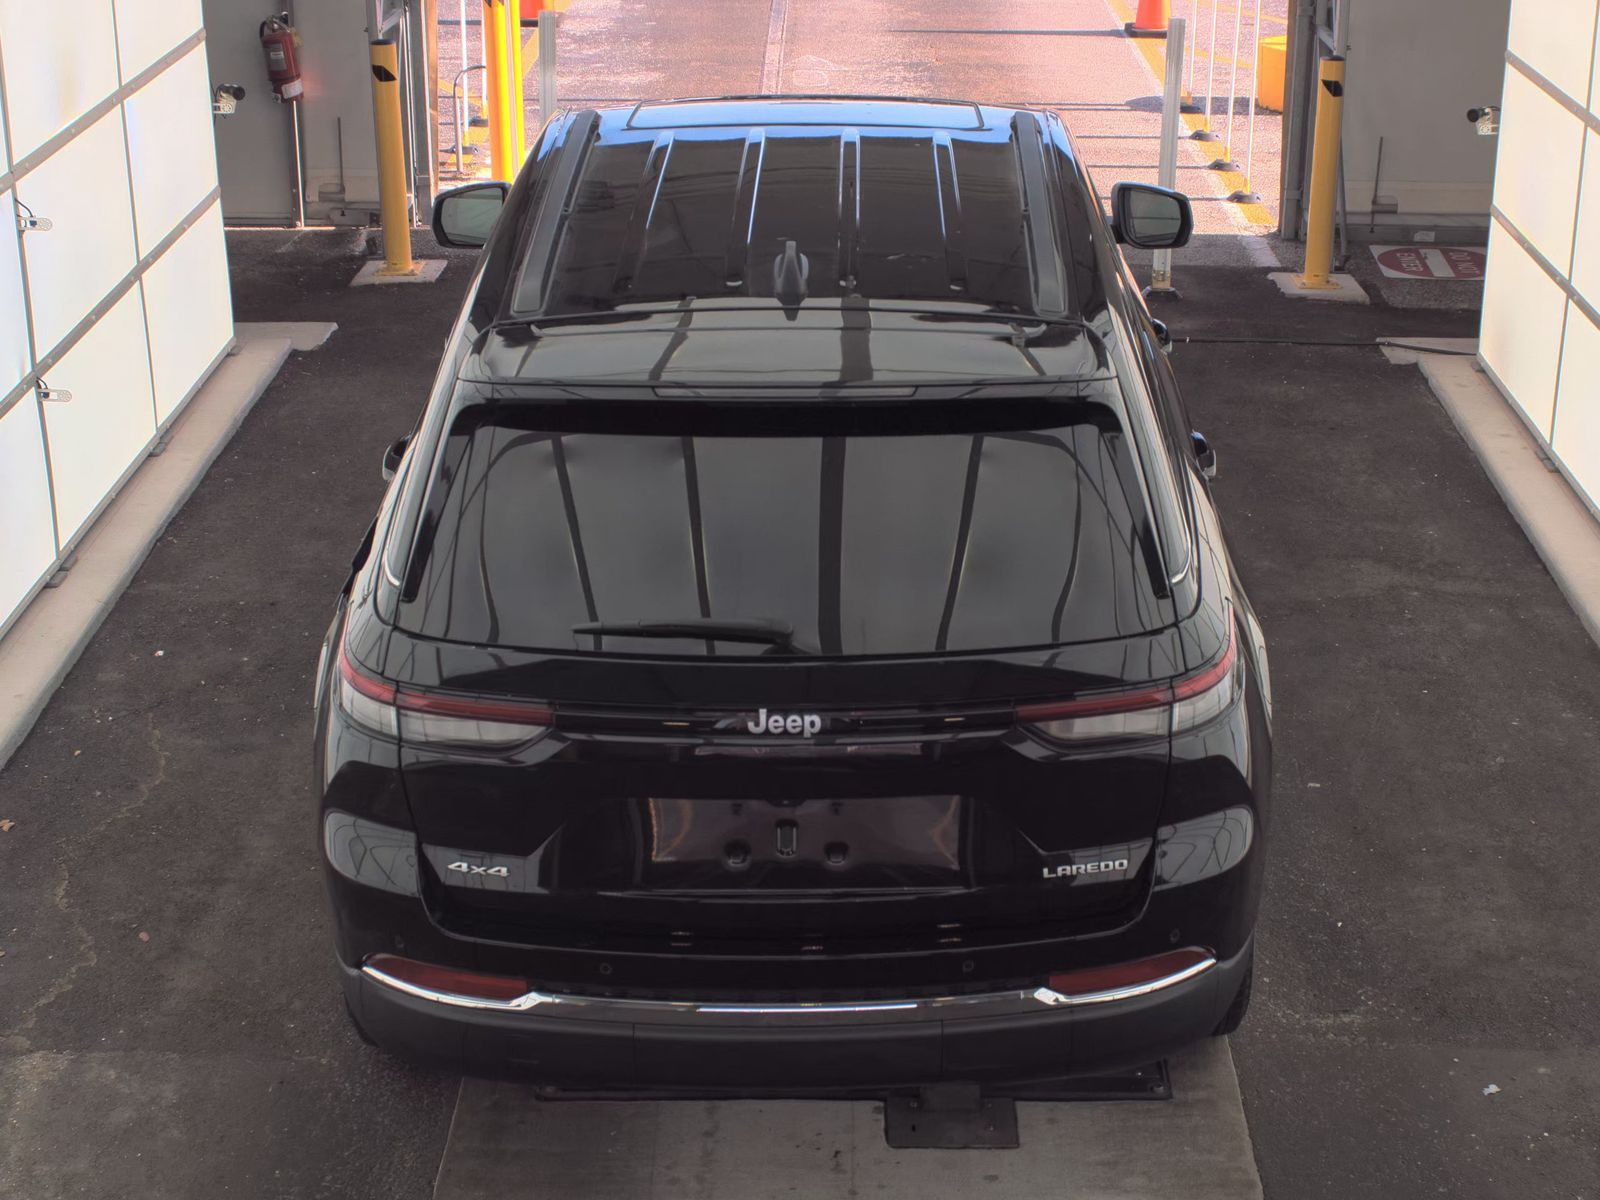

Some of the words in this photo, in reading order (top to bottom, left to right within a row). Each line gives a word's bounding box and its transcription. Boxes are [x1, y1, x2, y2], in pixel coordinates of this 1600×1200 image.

[1396, 253, 1423, 271] ENTER
[747, 708, 821, 738] Jeep
[447, 861, 509, 877] 4x4
[1042, 859, 1129, 878] LAREDO
